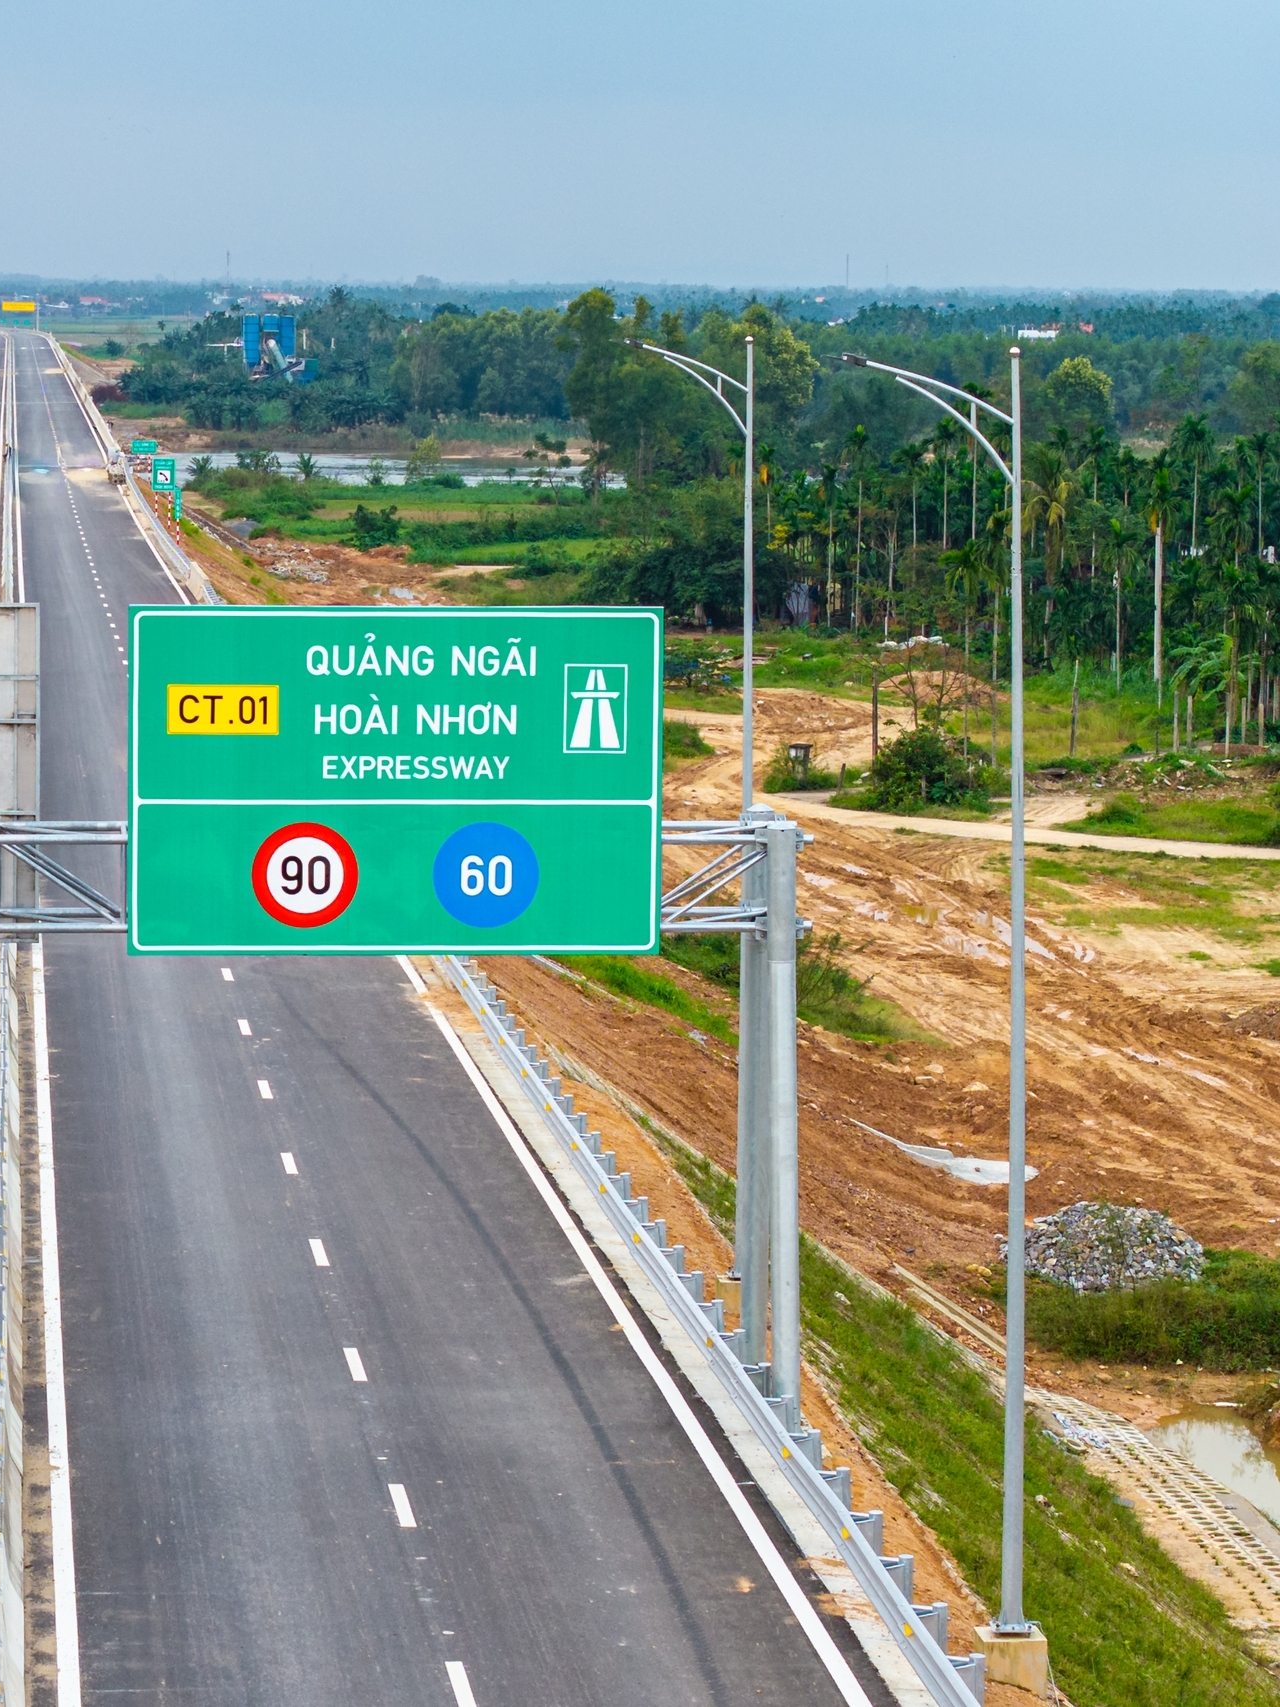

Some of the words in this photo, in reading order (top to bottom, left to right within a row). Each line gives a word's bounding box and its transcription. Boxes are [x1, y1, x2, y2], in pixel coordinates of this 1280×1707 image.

[306, 632, 435, 677] QUẢNG
[451, 637, 537, 677] NGÃI
[178, 694, 270, 726] CT.01
[314, 693, 399, 735] HOÀI
[416, 701, 518, 735] NHƠN
[322, 755, 510, 780] EXPRESSWAY
[280, 855, 332, 896] 90
[460, 855, 513, 896] 60
